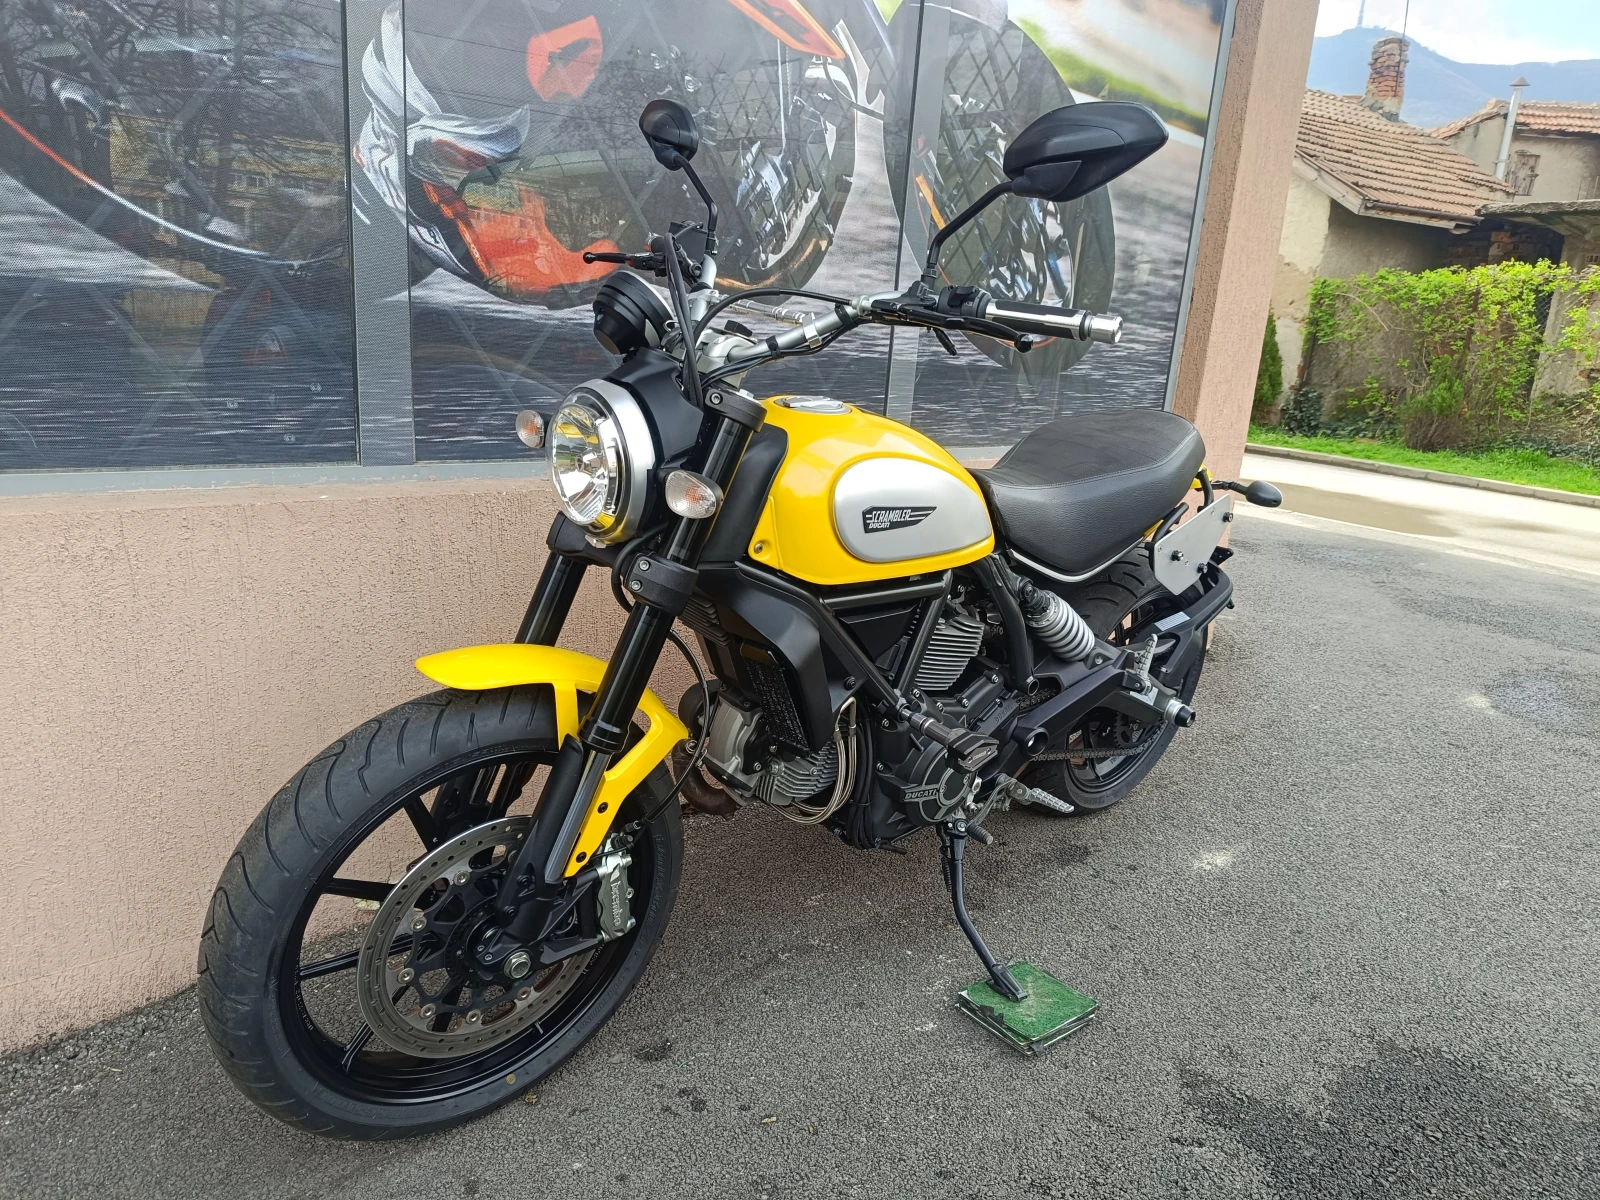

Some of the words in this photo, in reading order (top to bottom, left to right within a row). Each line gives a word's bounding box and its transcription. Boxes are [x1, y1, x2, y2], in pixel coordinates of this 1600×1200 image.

[872, 509, 911, 522] SCRAMBLER
[904, 788, 937, 799] DUCATI
[611, 881, 622, 926] brembo
